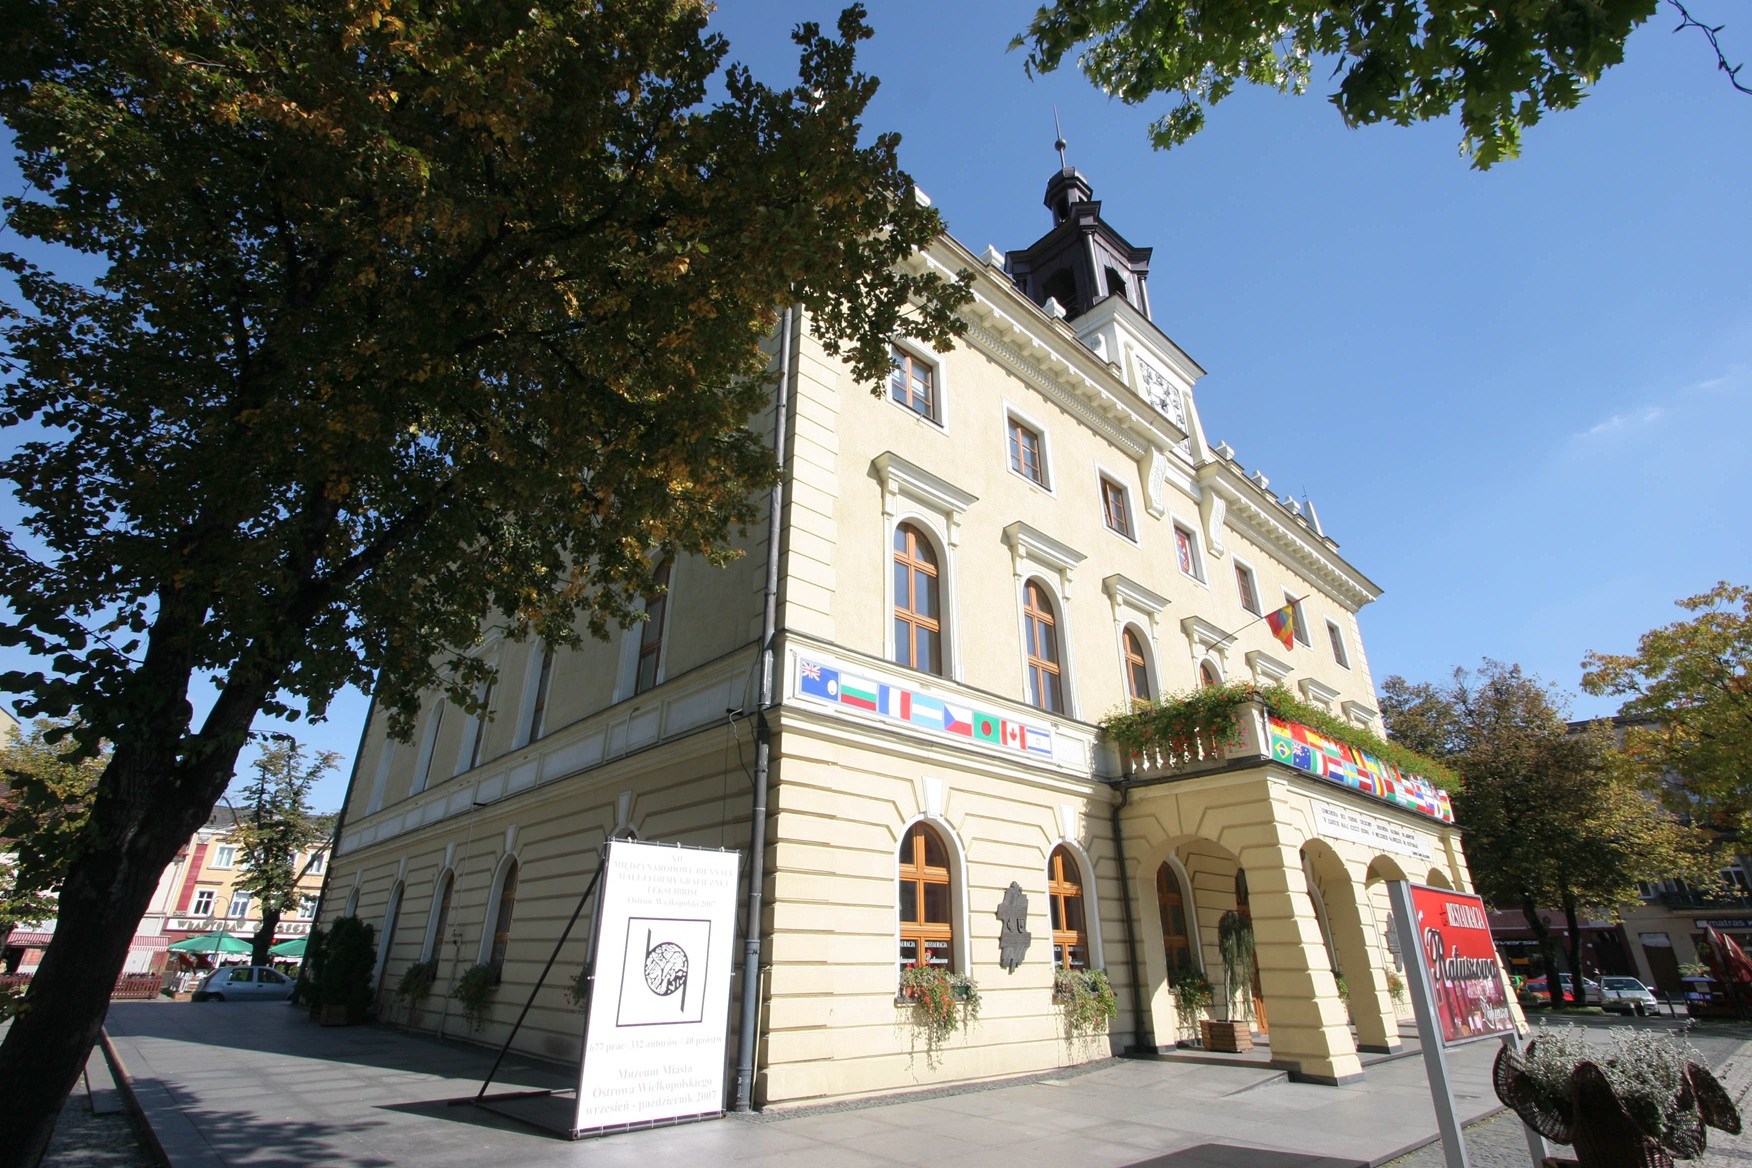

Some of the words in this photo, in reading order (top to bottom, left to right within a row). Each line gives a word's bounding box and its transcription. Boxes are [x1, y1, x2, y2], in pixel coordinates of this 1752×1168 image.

[589, 1042, 604, 1052] 677
[630, 1040, 644, 1050] 332
[646, 1038, 678, 1048] autorów
[617, 1068, 659, 1080] Muzeum
[662, 1064, 693, 1075] Miasta
[592, 1086, 635, 1098] Ostrowa
[638, 1078, 713, 1093] Wielkopolskiego
[586, 1101, 630, 1115] wrzesień
[638, 1093, 693, 1112] październik
[696, 1090, 717, 1102] 2007
